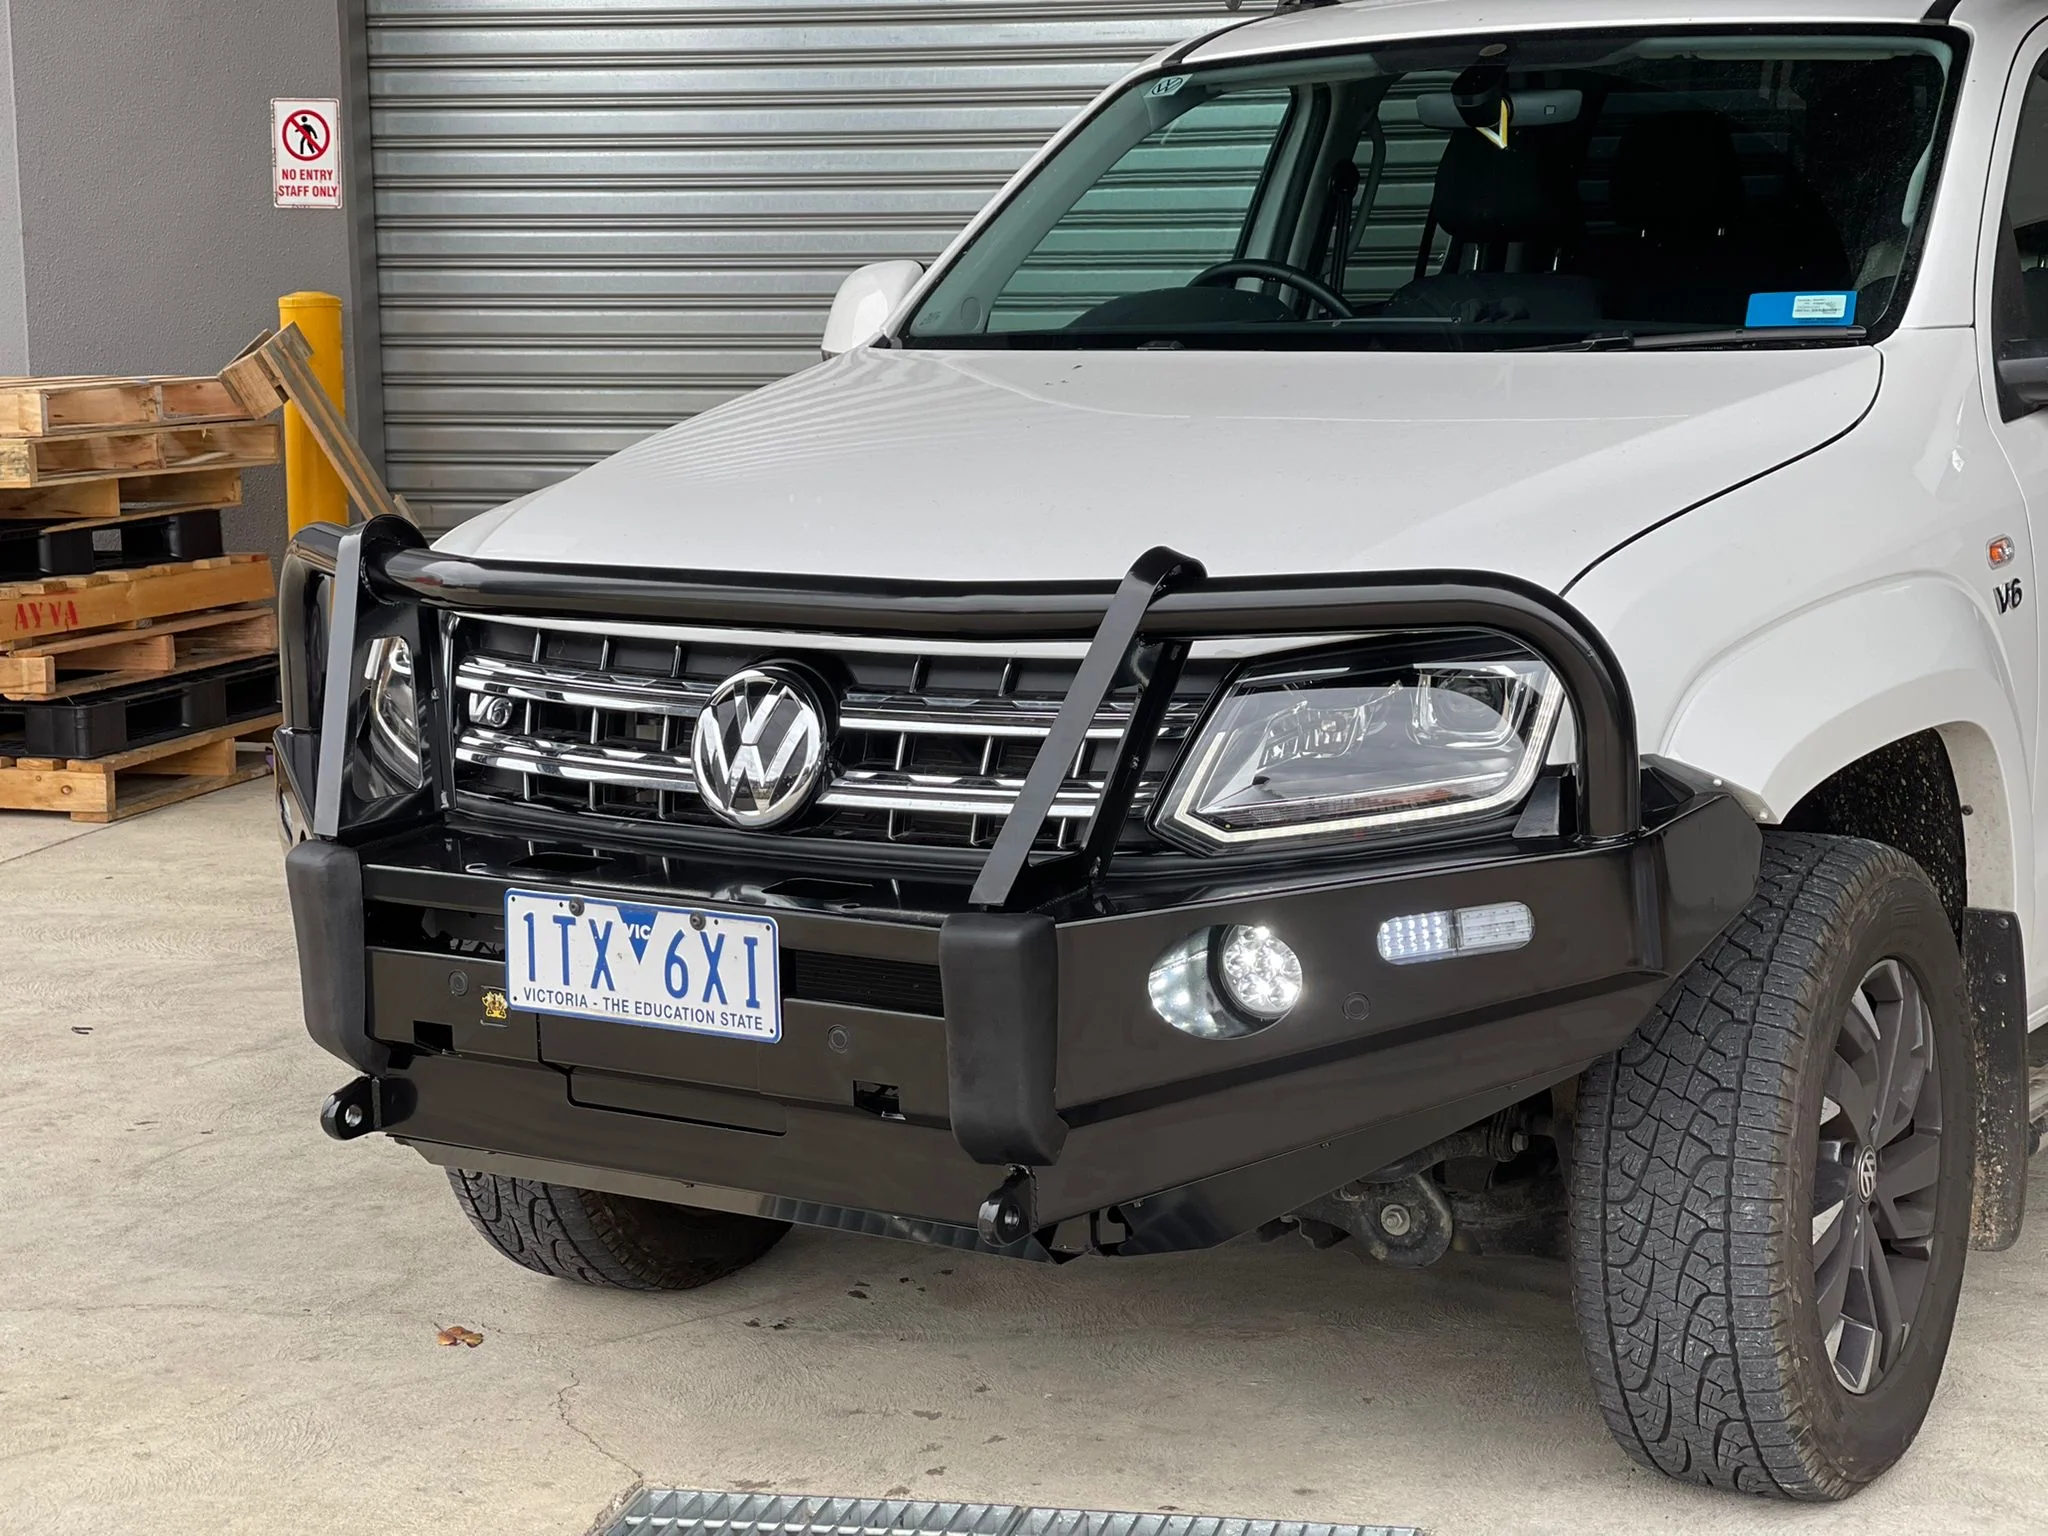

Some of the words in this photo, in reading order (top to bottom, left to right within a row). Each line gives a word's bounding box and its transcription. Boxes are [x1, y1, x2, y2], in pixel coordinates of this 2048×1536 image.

[278, 185, 309, 196] STAFF
[312, 186, 338, 197] ONLY
[282, 169, 296, 180] NO
[300, 169, 333, 180] ENTRY
[1994, 578, 2022, 614] V6
[469, 692, 512, 727] V6
[523, 987, 588, 1008] VICTORIA
[602, 997, 629, 1013] THE
[634, 1001, 715, 1024] EDUCATION
[720, 1012, 763, 1030] STATE
